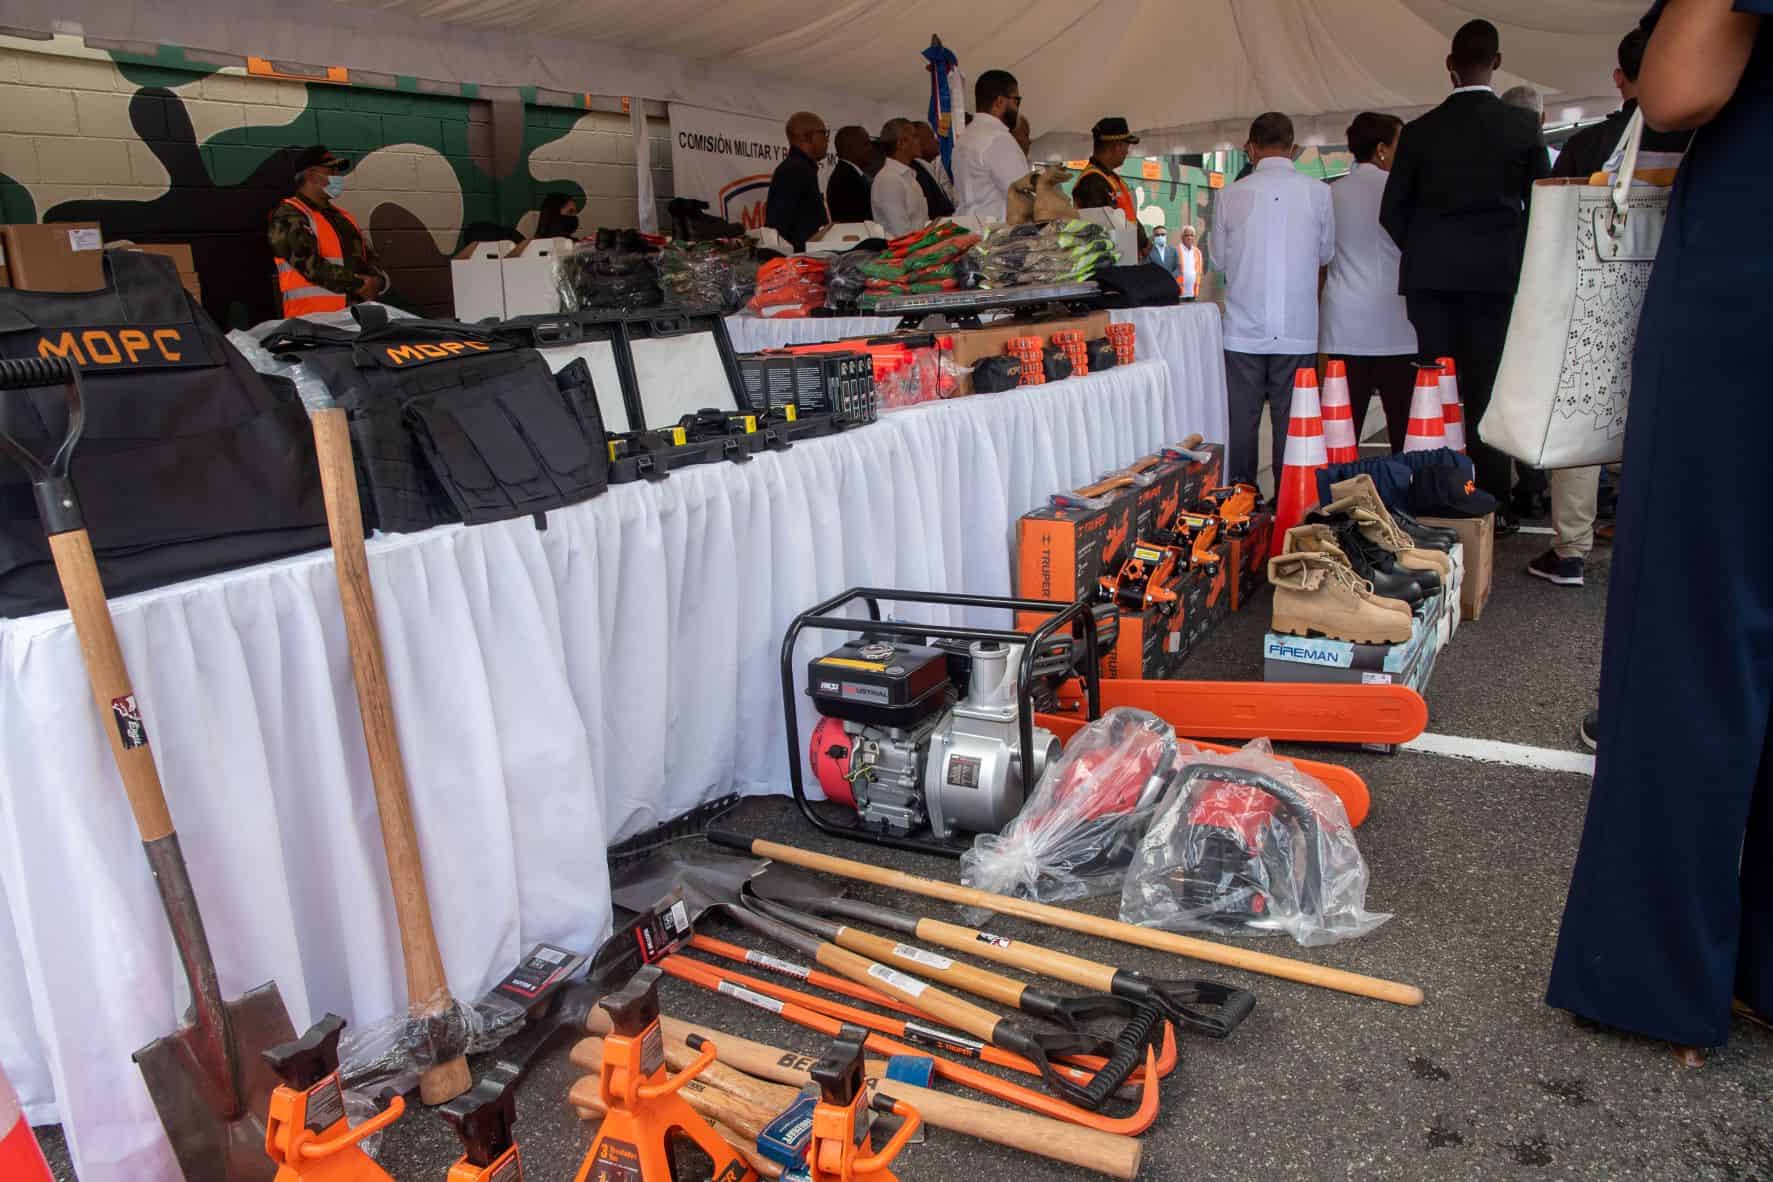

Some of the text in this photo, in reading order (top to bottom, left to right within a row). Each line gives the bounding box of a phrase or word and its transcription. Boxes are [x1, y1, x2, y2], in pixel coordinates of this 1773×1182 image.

[678, 130, 733, 155] COMISIÓN
[733, 139, 772, 160] MILITAR
[772, 145, 781, 161] Y
[38, 328, 182, 366] MOPC
[386, 340, 490, 366] MOPC
[1041, 549, 1051, 598] TRUPER
